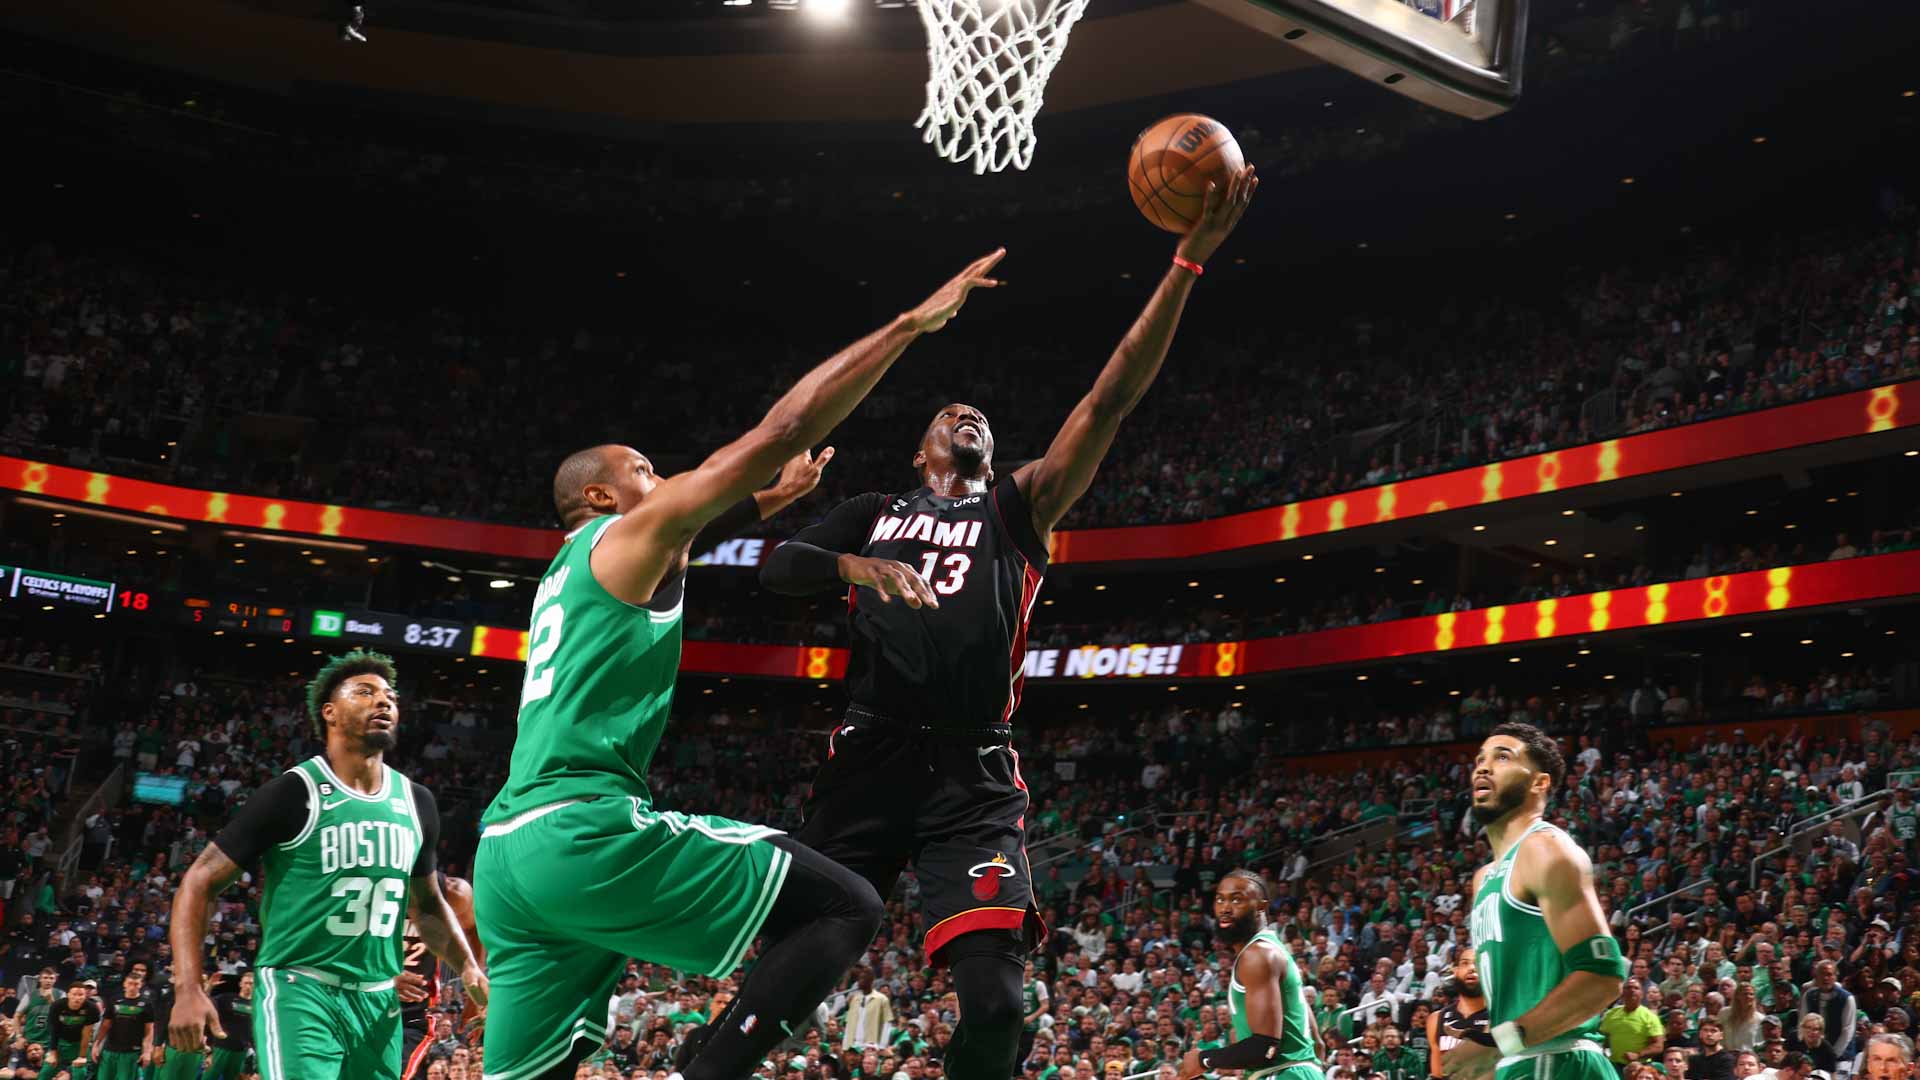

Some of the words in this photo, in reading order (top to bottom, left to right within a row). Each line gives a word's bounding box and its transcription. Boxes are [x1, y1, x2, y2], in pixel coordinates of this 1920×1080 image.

[868, 513, 983, 548] MIAMI
[21, 576, 60, 591] CELTICS
[60, 582, 109, 598] PLAYOFFS
[919, 550, 972, 595] 13
[118, 590, 150, 610] 18
[314, 614, 342, 632] TD
[345, 620, 384, 635] Bank
[404, 623, 461, 648] 8:37
[521, 602, 565, 709] 2
[1063, 645, 1183, 676] NOISE!
[320, 820, 417, 876] BOSTON
[325, 876, 406, 938] 36
